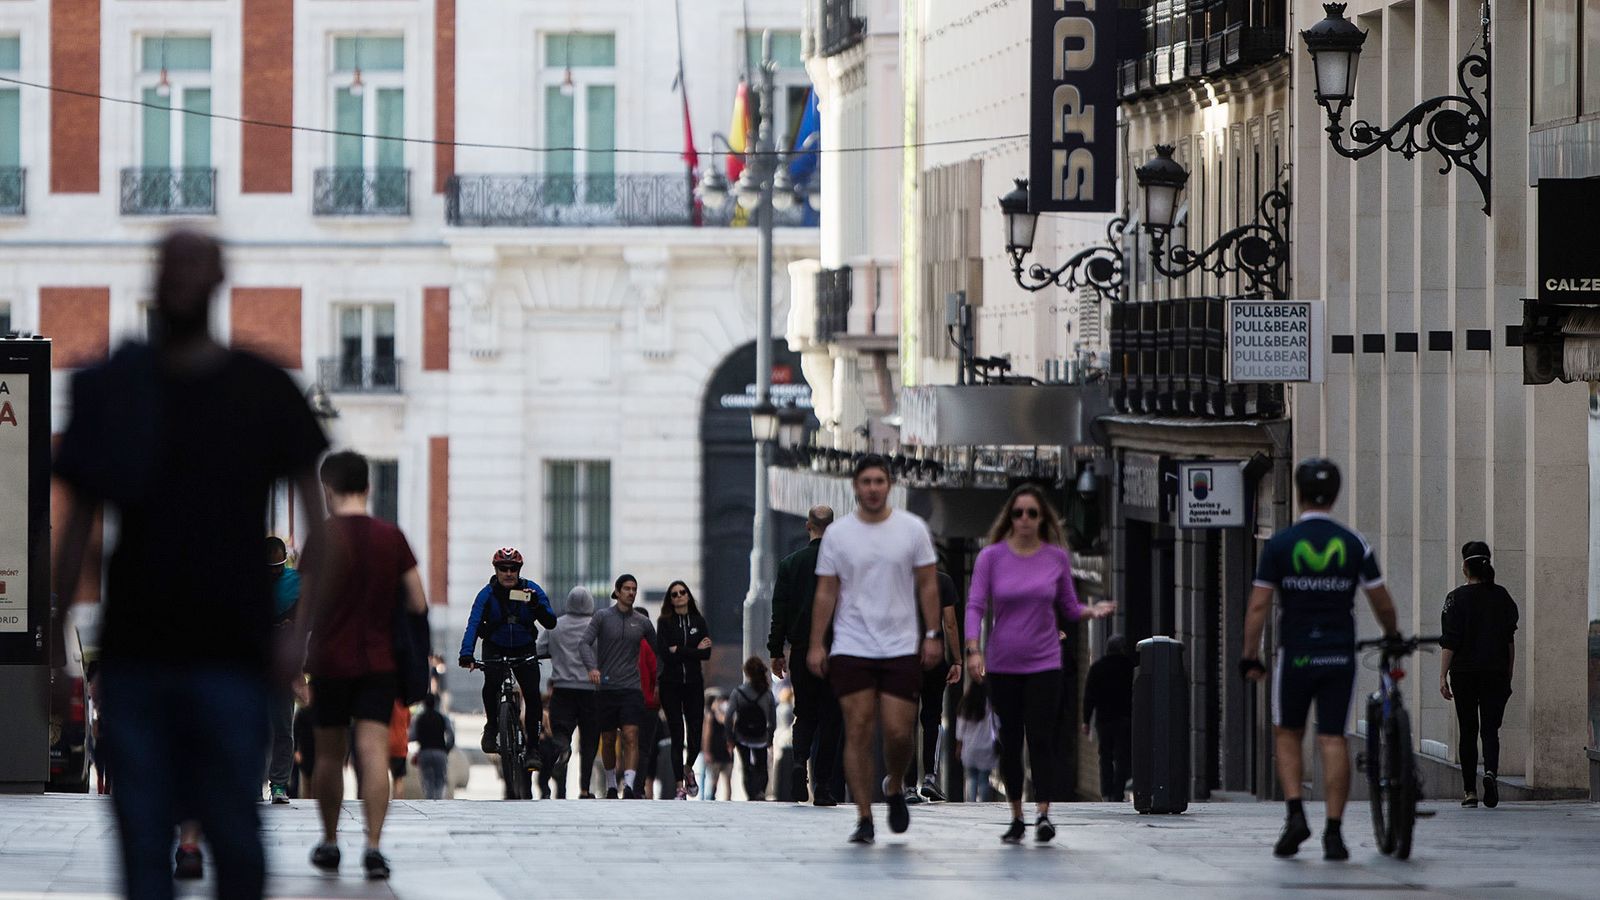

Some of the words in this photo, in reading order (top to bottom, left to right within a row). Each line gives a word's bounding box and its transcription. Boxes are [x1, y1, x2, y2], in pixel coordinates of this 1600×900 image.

[1052, 0, 1096, 201] SPO
[1545, 278, 1600, 291] CALZE
[1235, 306, 1307, 317] PULL&BEAR
[1235, 320, 1307, 332] PULL&BEAR
[1235, 335, 1307, 347] PULL&BEAR
[1235, 350, 1307, 362] PULL&BEAR
[1235, 365, 1307, 377] PULL&BEAR
[1282, 576, 1352, 592] movistar
[1311, 655, 1349, 666] movistar
